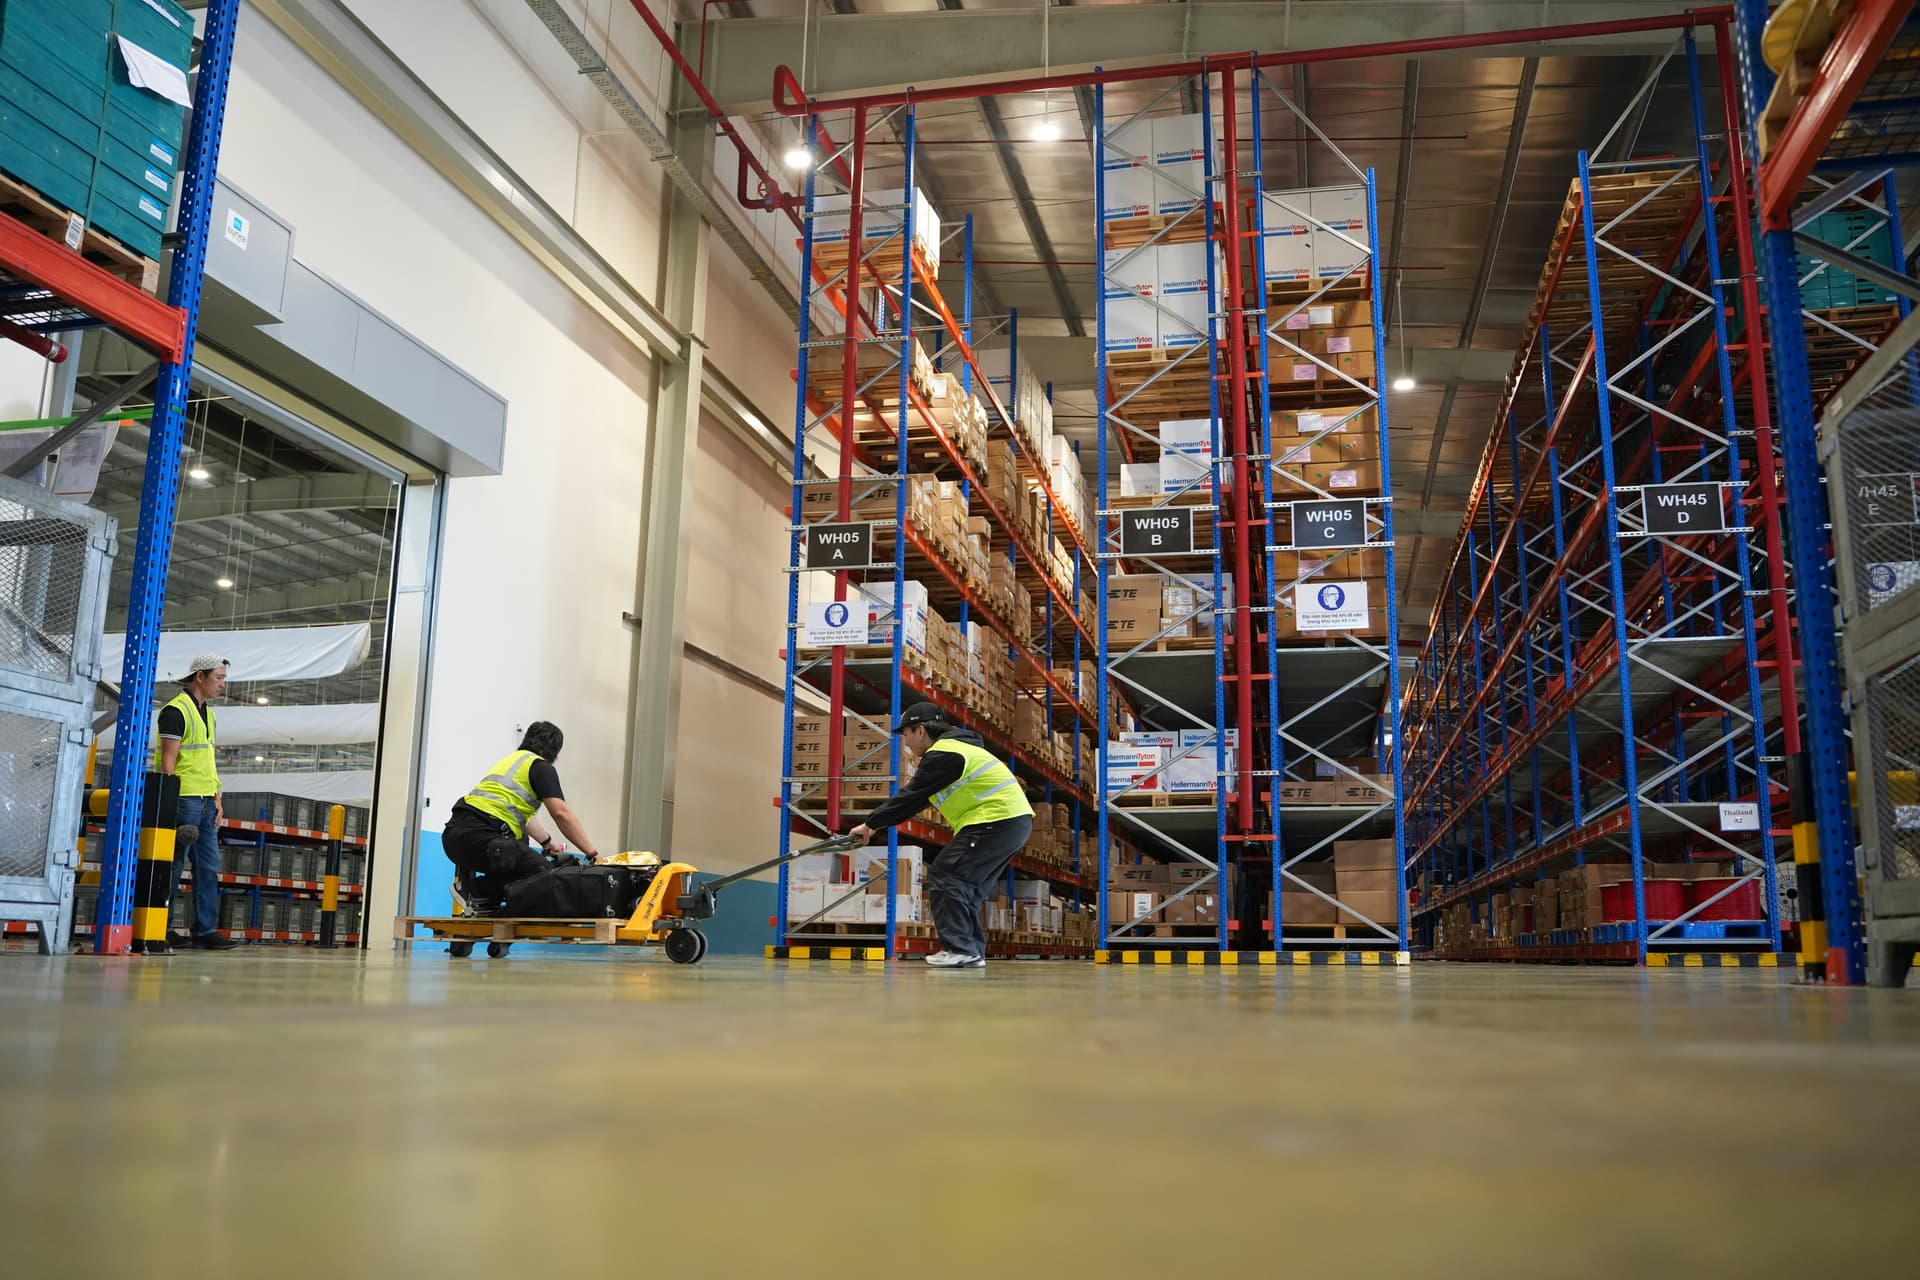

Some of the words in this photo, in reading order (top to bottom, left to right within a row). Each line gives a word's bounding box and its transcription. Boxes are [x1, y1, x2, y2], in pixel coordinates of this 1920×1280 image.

[1858, 485, 1898, 498] H45
[1657, 493, 1707, 507] WH45
[1306, 509, 1352, 522] WH05
[1868, 504, 1880, 515] E
[1134, 517, 1179, 530] WH05
[1677, 512, 1690, 524] D
[818, 532, 860, 544] WH05
[1323, 527, 1336, 538] C
[1151, 534, 1162, 546] B
[832, 548, 844, 559] A
